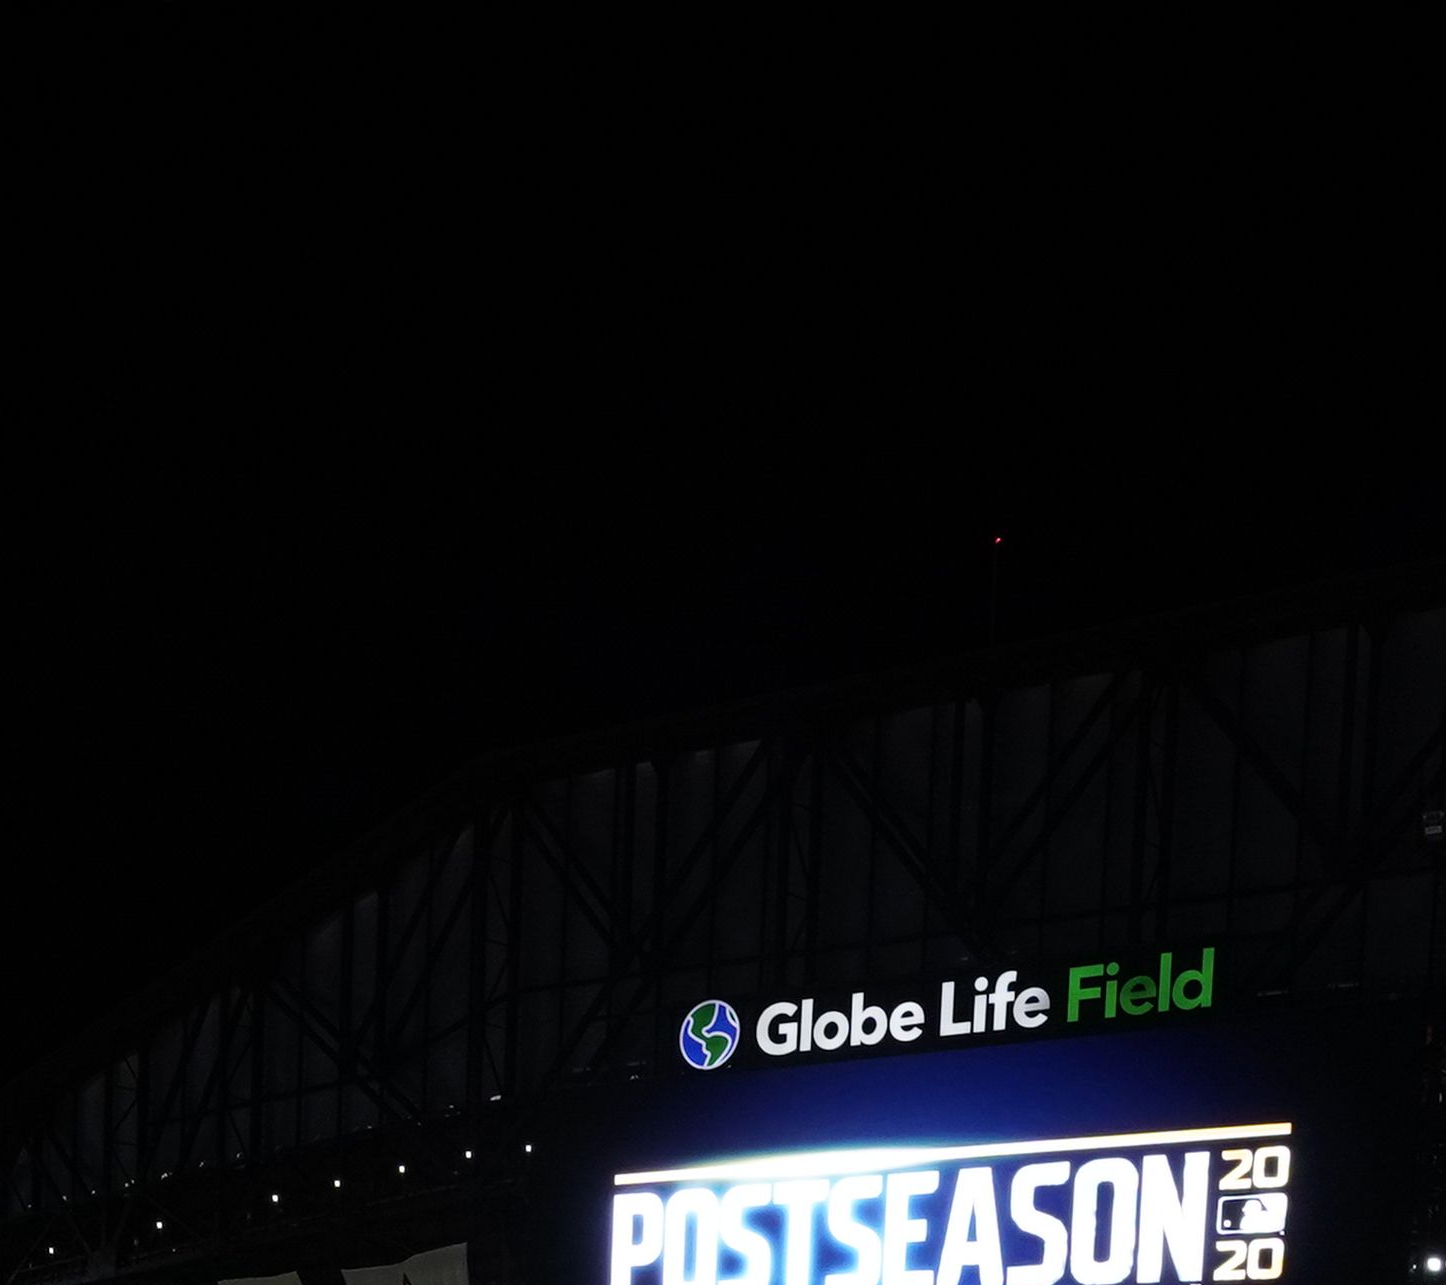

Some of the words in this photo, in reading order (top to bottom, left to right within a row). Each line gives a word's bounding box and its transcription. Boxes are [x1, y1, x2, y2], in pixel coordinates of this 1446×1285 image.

[756, 991, 924, 1057] Globe
[940, 970, 1049, 1037] Life
[1066, 948, 1215, 1022] Field
[1220, 1146, 1291, 1189] 20
[1213, 1237, 1283, 1282] 20
